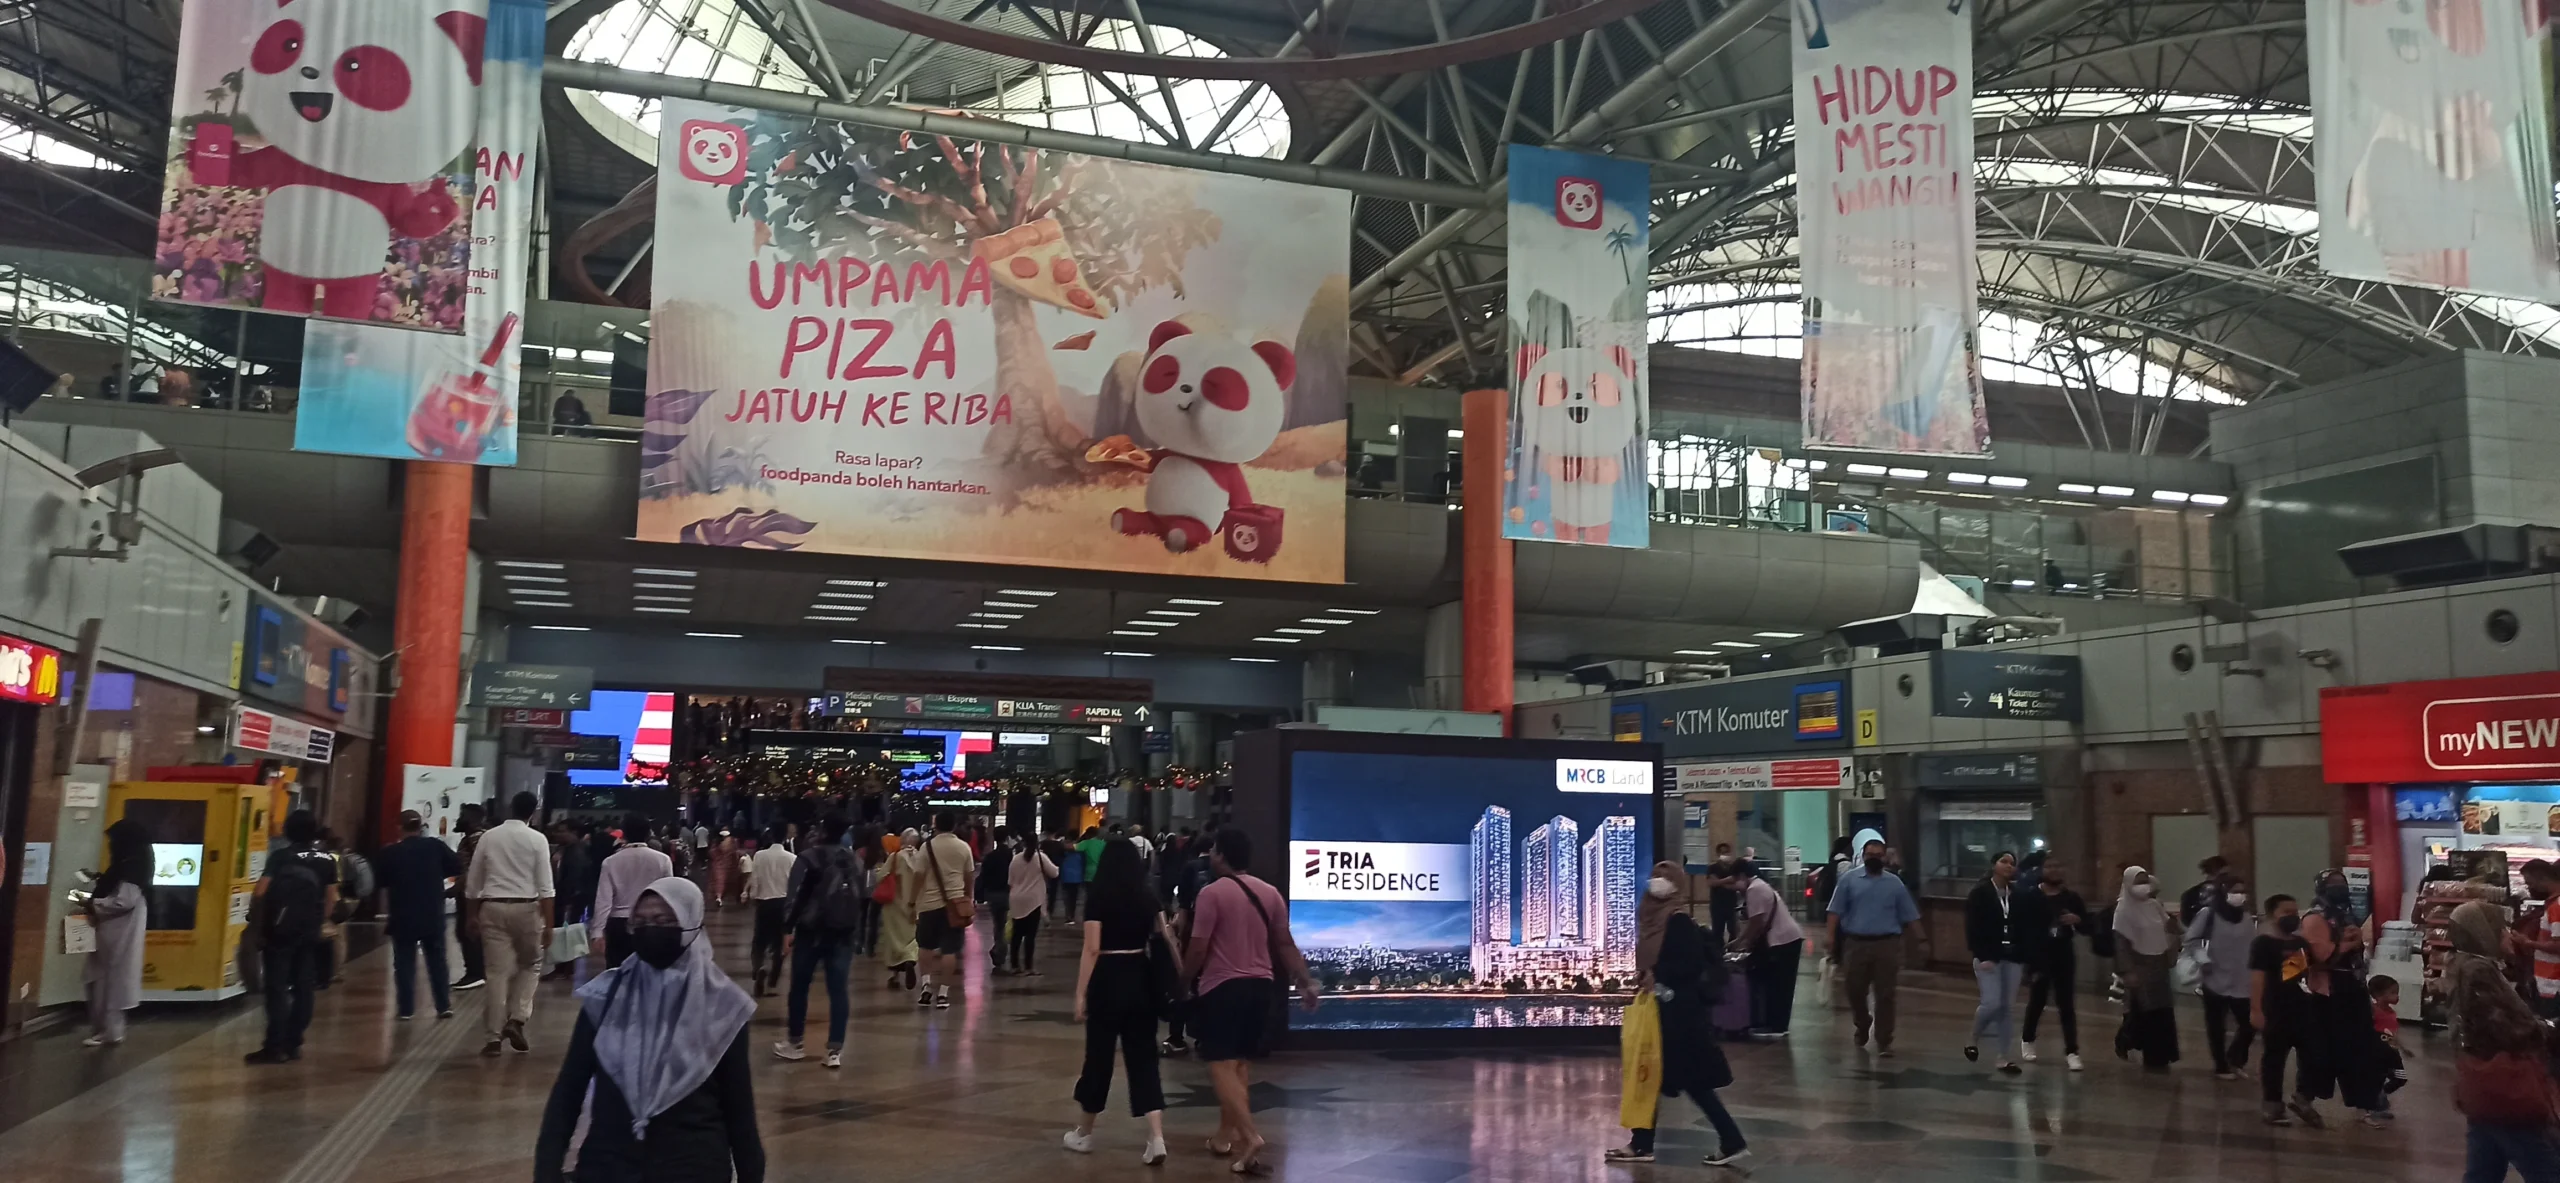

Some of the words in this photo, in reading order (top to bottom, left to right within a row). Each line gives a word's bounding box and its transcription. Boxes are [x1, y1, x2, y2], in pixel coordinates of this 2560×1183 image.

[1813, 63, 1958, 125] HIDUP
[1834, 121, 1947, 173] MESTI
[1832, 170, 1960, 216] WANGI!
[749, 255, 992, 310] UMPAMA
[779, 315, 956, 381] PIZA
[724, 387, 848, 424] JATUH
[861, 391, 911, 428] KE
[924, 391, 1013, 426] RIBA
[834, 450, 872, 467] Rasa
[875, 452, 924, 471] lapar?
[759, 464, 853, 486] foodpanda
[855, 472, 903, 491] boleh
[906, 476, 992, 496] hantarkan.
[829, 695, 840, 708] P
[947, 694, 978, 704] Ekspres
[1015, 701, 1035, 711] KLIA
[1085, 707, 1110, 717] RAPID
[1111, 707, 1123, 718] KL
[1675, 708, 1712, 736] KTM
[1717, 706, 1790, 732] Komuter
[1861, 719, 1873, 739] D
[1566, 768, 1606, 785] MRCB
[1612, 770, 1645, 786] Land
[1326, 851, 1375, 870] TRIA
[1326, 872, 1440, 892] RESIDENCE
